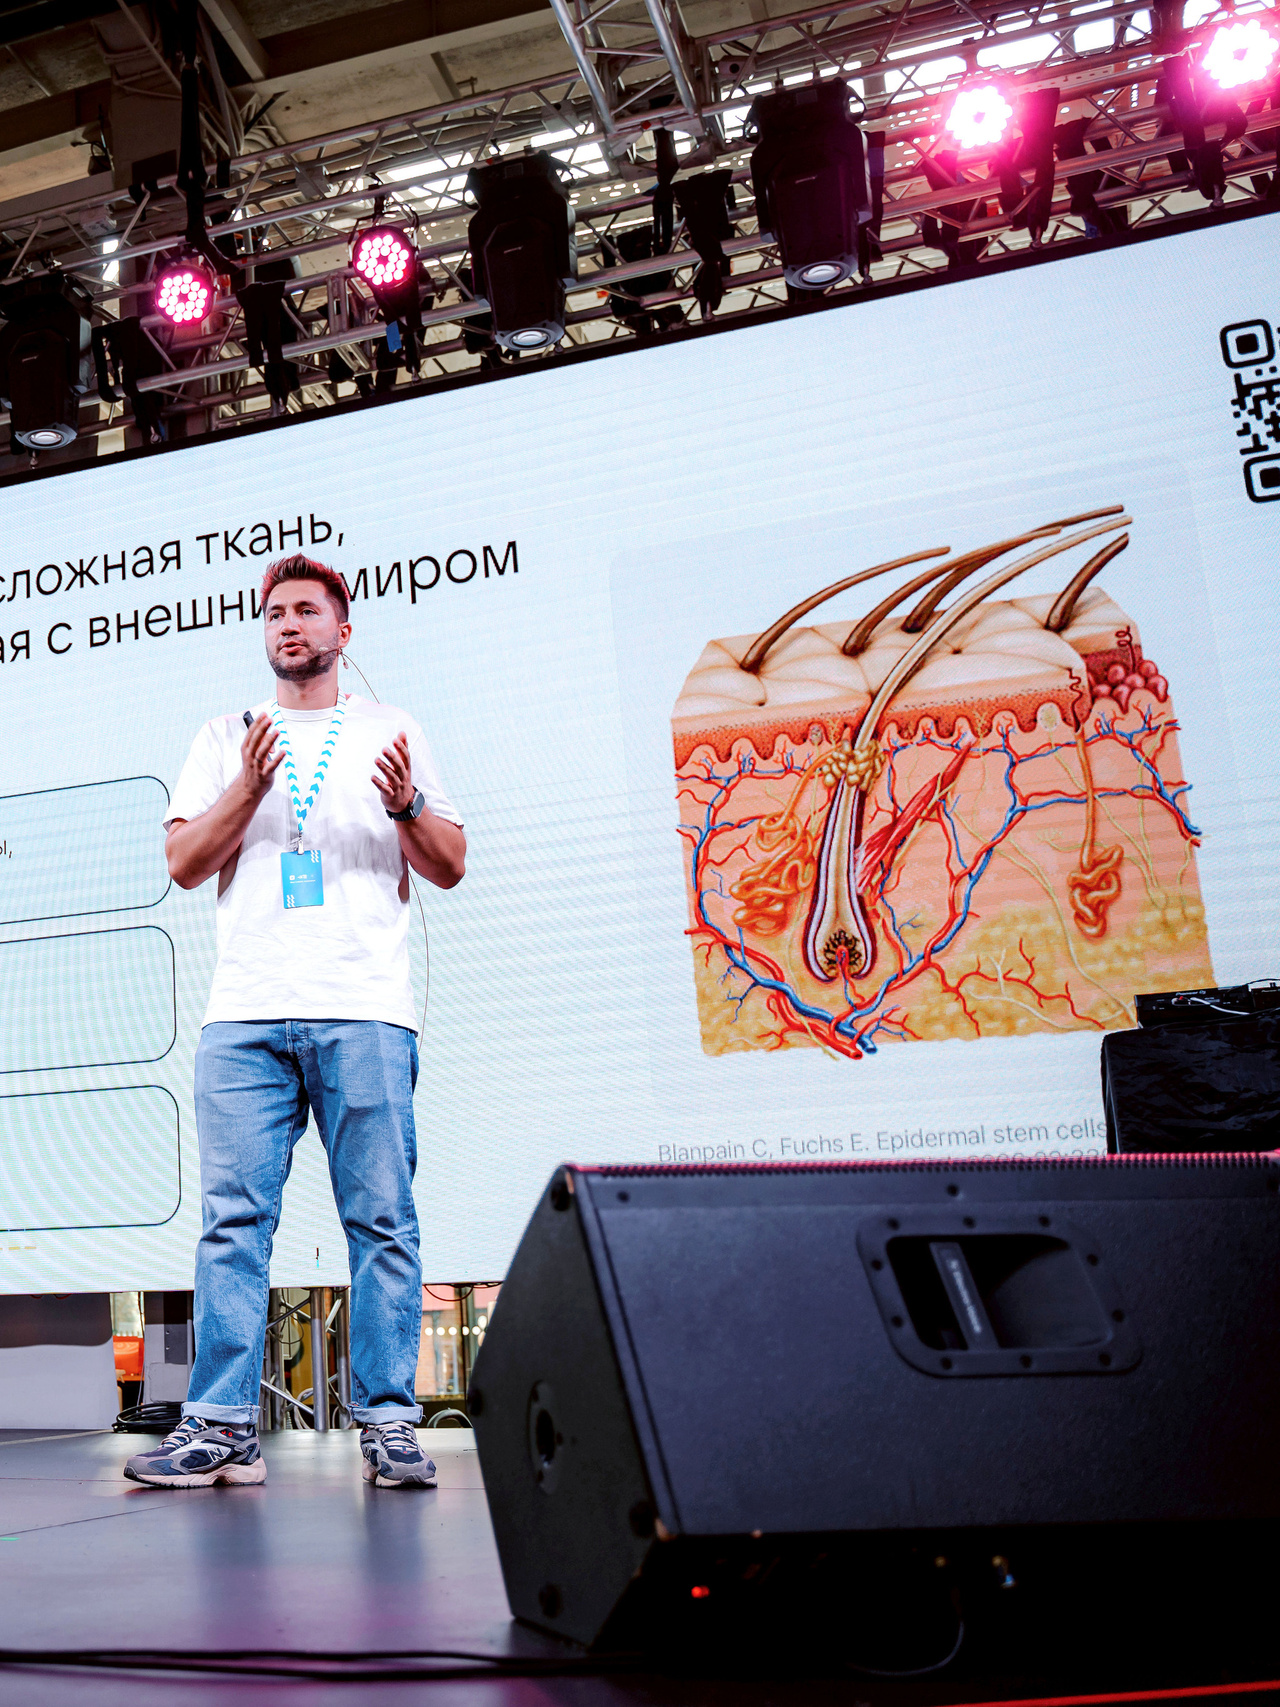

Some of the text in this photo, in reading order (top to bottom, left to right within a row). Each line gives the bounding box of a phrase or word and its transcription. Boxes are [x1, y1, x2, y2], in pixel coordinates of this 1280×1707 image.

[196, 513, 344, 564] ткань,
[48, 621, 72, 654] с
[89, 589, 262, 648] внешн
[338, 540, 519, 604] миром
[658, 1118, 1107, 1163] Blanpain C, Fuchs E. Epidermal stem cells
